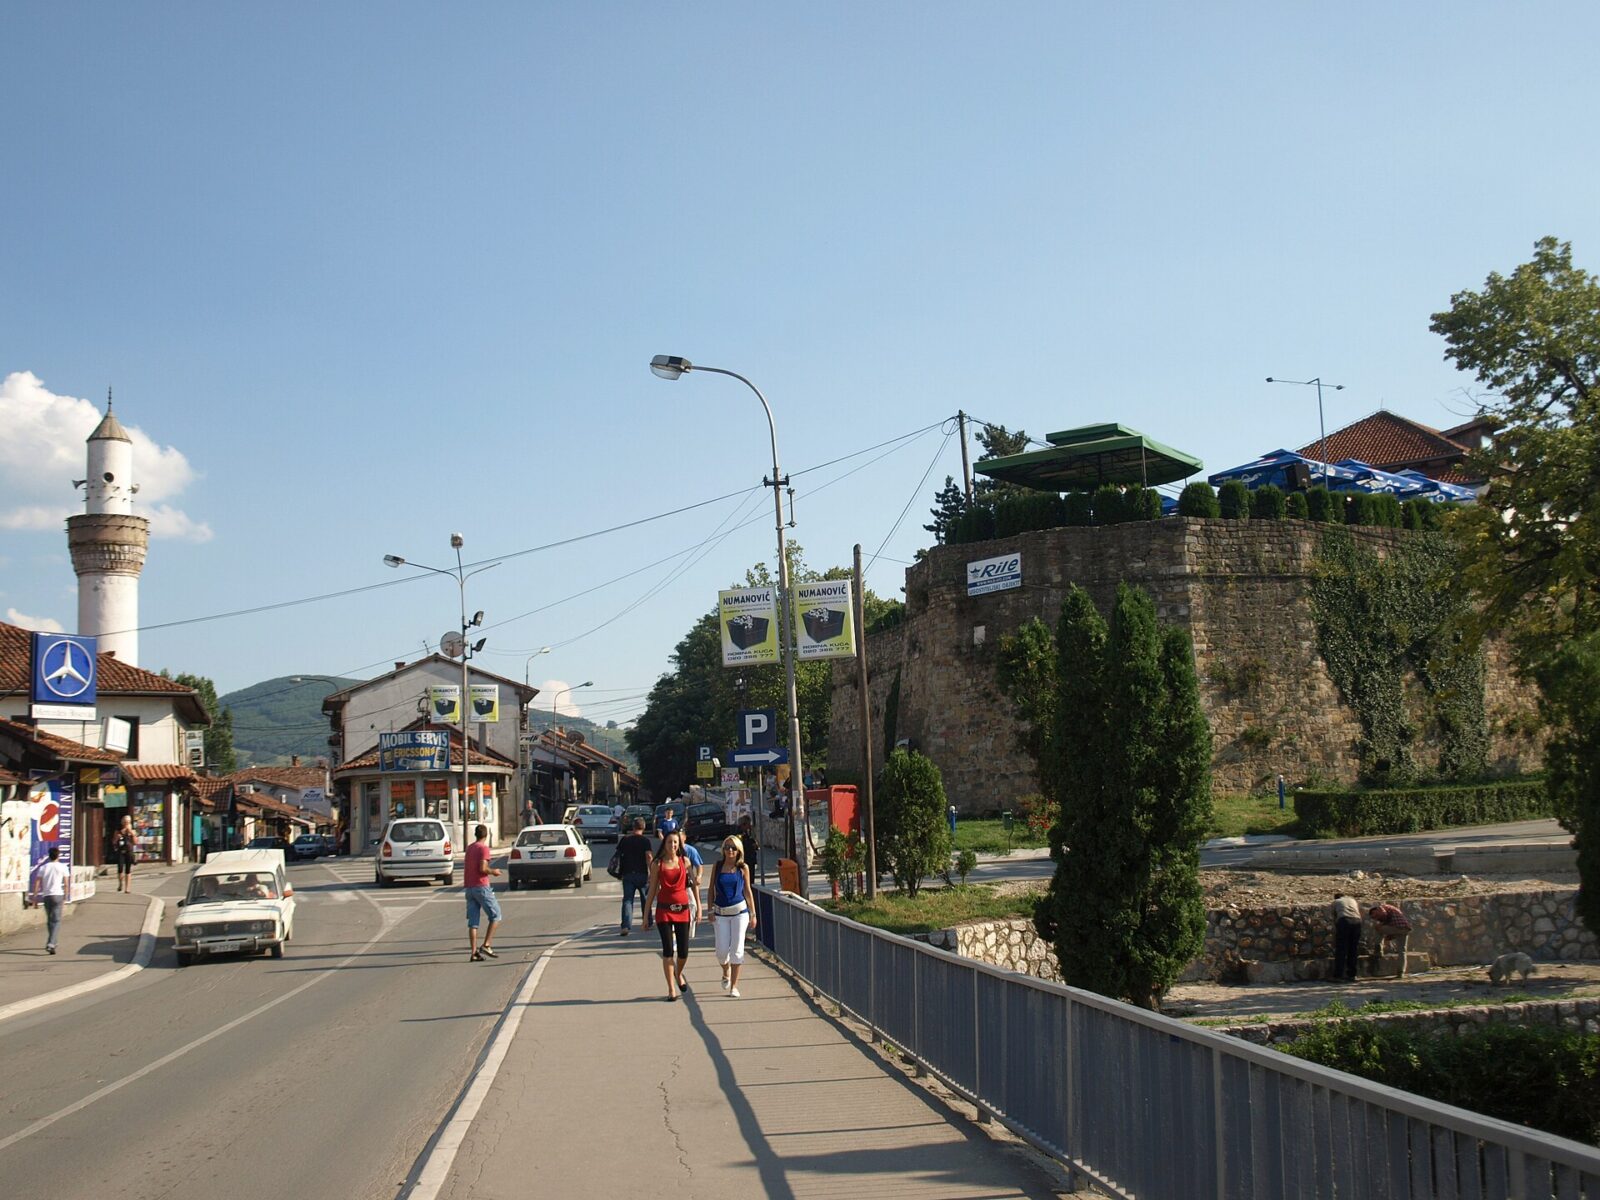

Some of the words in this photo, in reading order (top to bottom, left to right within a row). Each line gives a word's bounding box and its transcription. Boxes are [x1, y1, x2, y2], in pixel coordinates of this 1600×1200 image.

[980, 559, 1018, 577] Rile
[723, 591, 771, 605] NUMANOVIĆ
[798, 584, 847, 598] NUMANOVIĆ
[745, 713, 768, 745] P
[381, 733, 413, 749] MOBIL
[415, 732, 448, 747] SERVIS
[394, 747, 431, 758] ERICSSON
[700, 747, 710, 760] P
